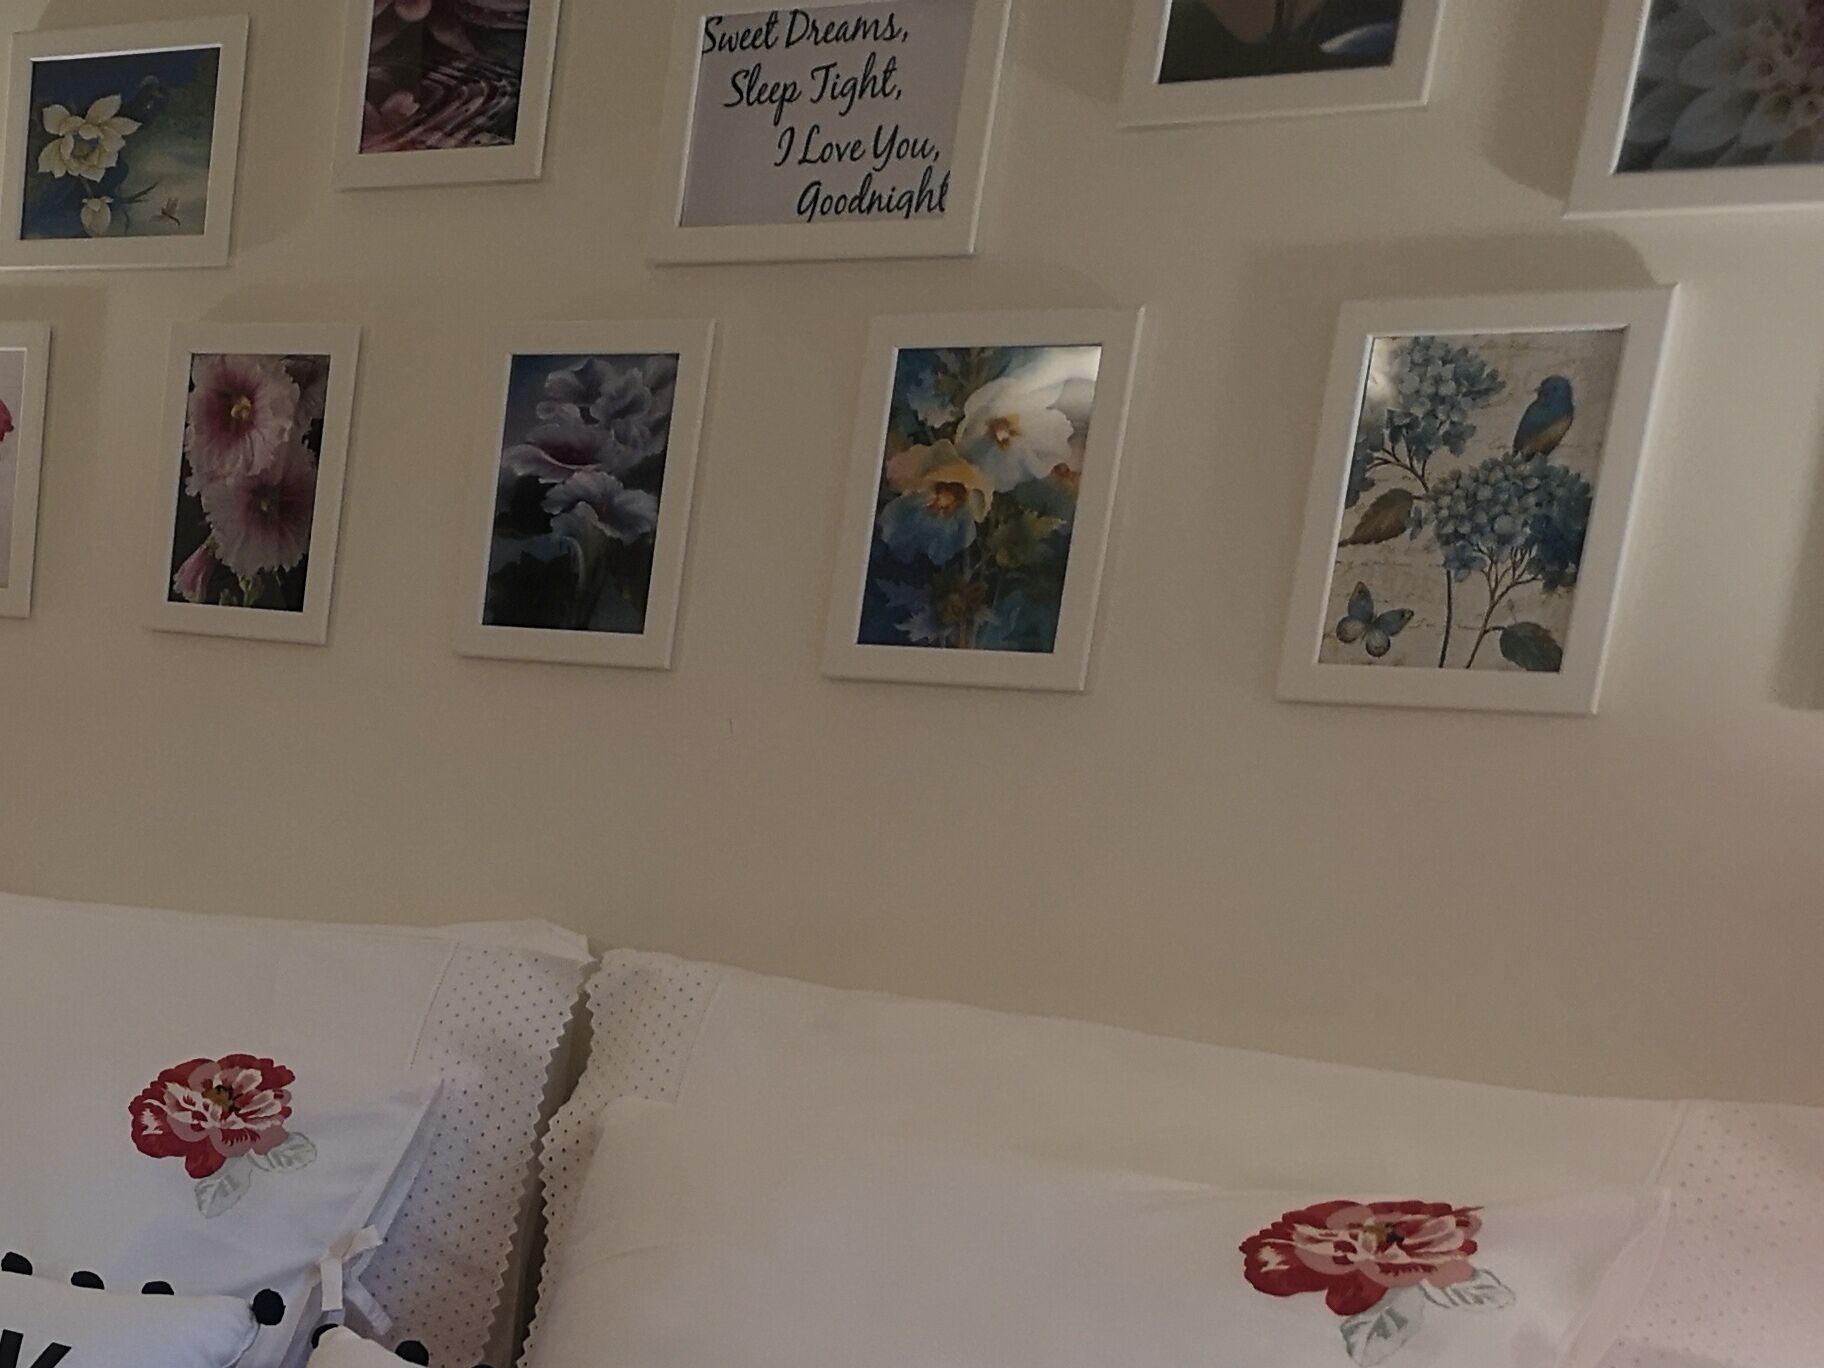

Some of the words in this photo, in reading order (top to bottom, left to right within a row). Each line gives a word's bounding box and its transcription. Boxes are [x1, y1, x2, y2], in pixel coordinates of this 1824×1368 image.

[702, 10, 780, 54] Sweet
[784, 8, 908, 49] Dreams,
[723, 62, 803, 127] Sleep
[810, 51, 903, 117] Tight,
[773, 125, 796, 167] I
[797, 124, 866, 166] Love
[872, 124, 940, 173] You,
[796, 165, 952, 223] Goodnight
